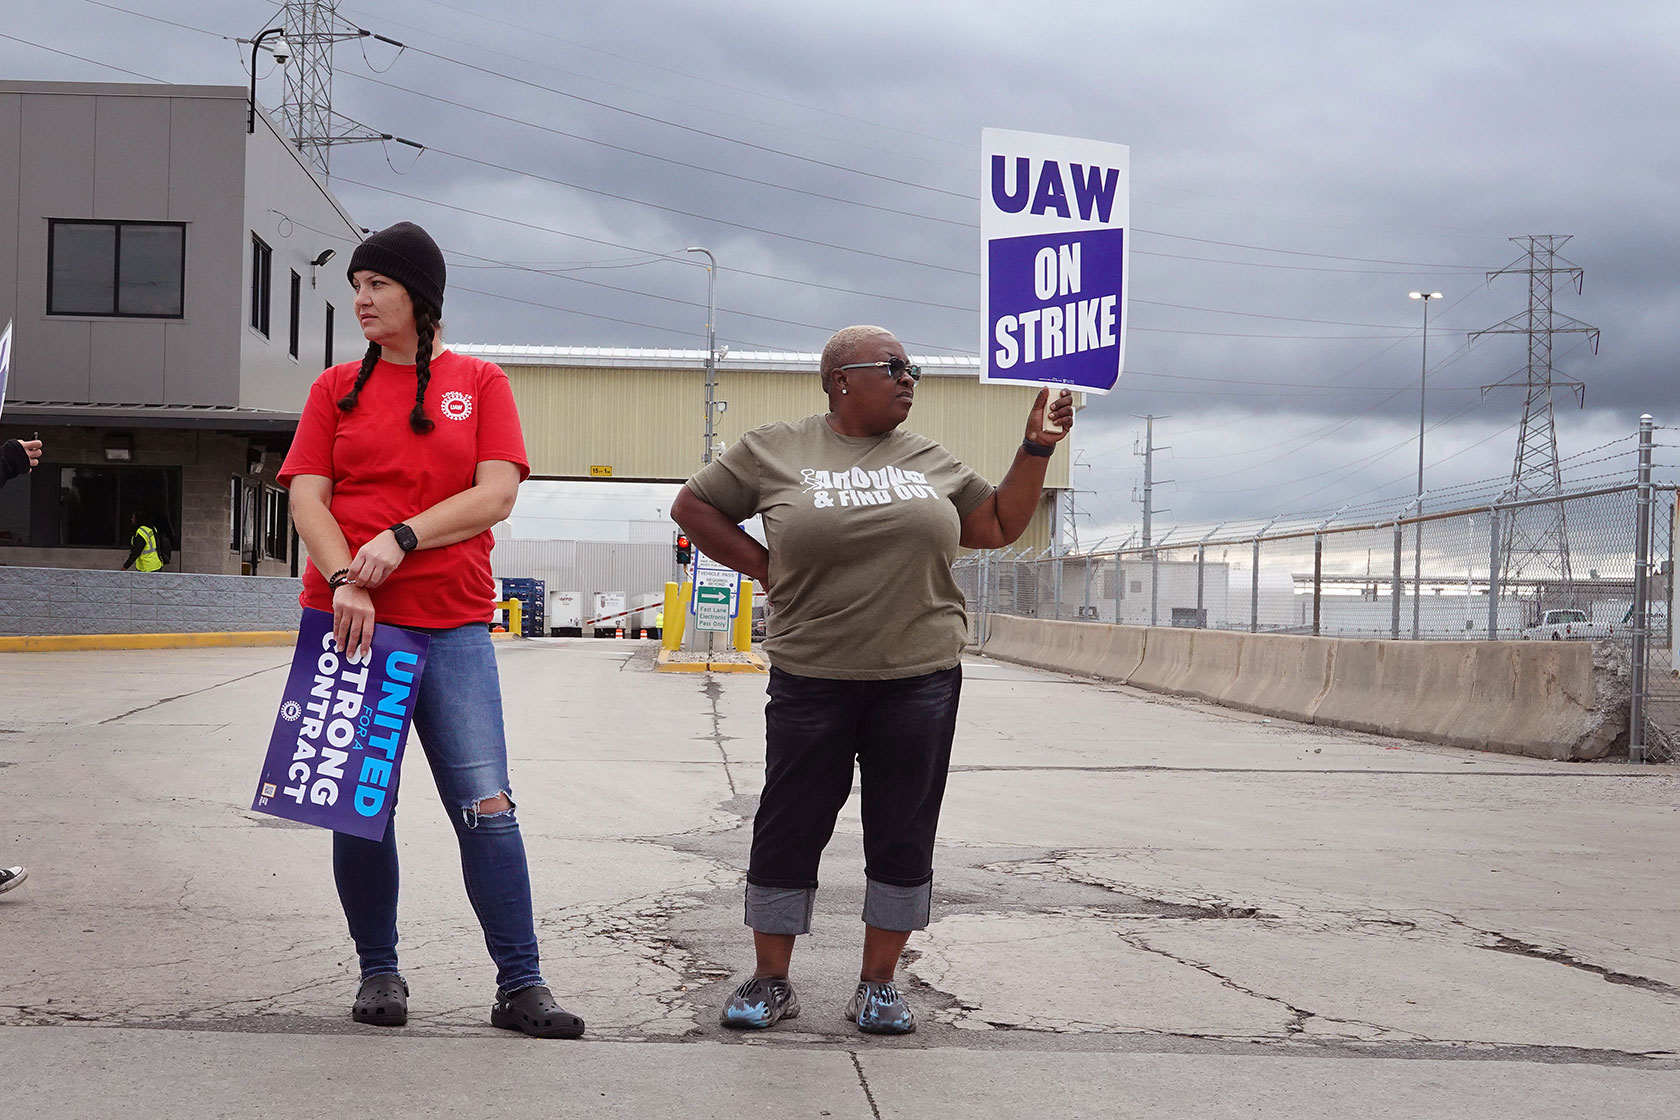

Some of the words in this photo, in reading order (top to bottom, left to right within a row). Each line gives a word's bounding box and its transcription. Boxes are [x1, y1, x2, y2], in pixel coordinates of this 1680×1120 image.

[991, 154, 1120, 223] UAW
[1034, 242, 1081, 300] ON
[995, 294, 1117, 370] STRIKE
[813, 465, 929, 490] AROUND
[813, 490, 835, 508] &
[838, 489, 892, 507] FIND
[893, 484, 940, 500] OUT
[282, 631, 340, 805] CONTRACT
[310, 643, 373, 807] STRONG
[352, 740, 364, 751] A
[353, 650, 419, 817] UNITED
[355, 704, 373, 739] FOR
